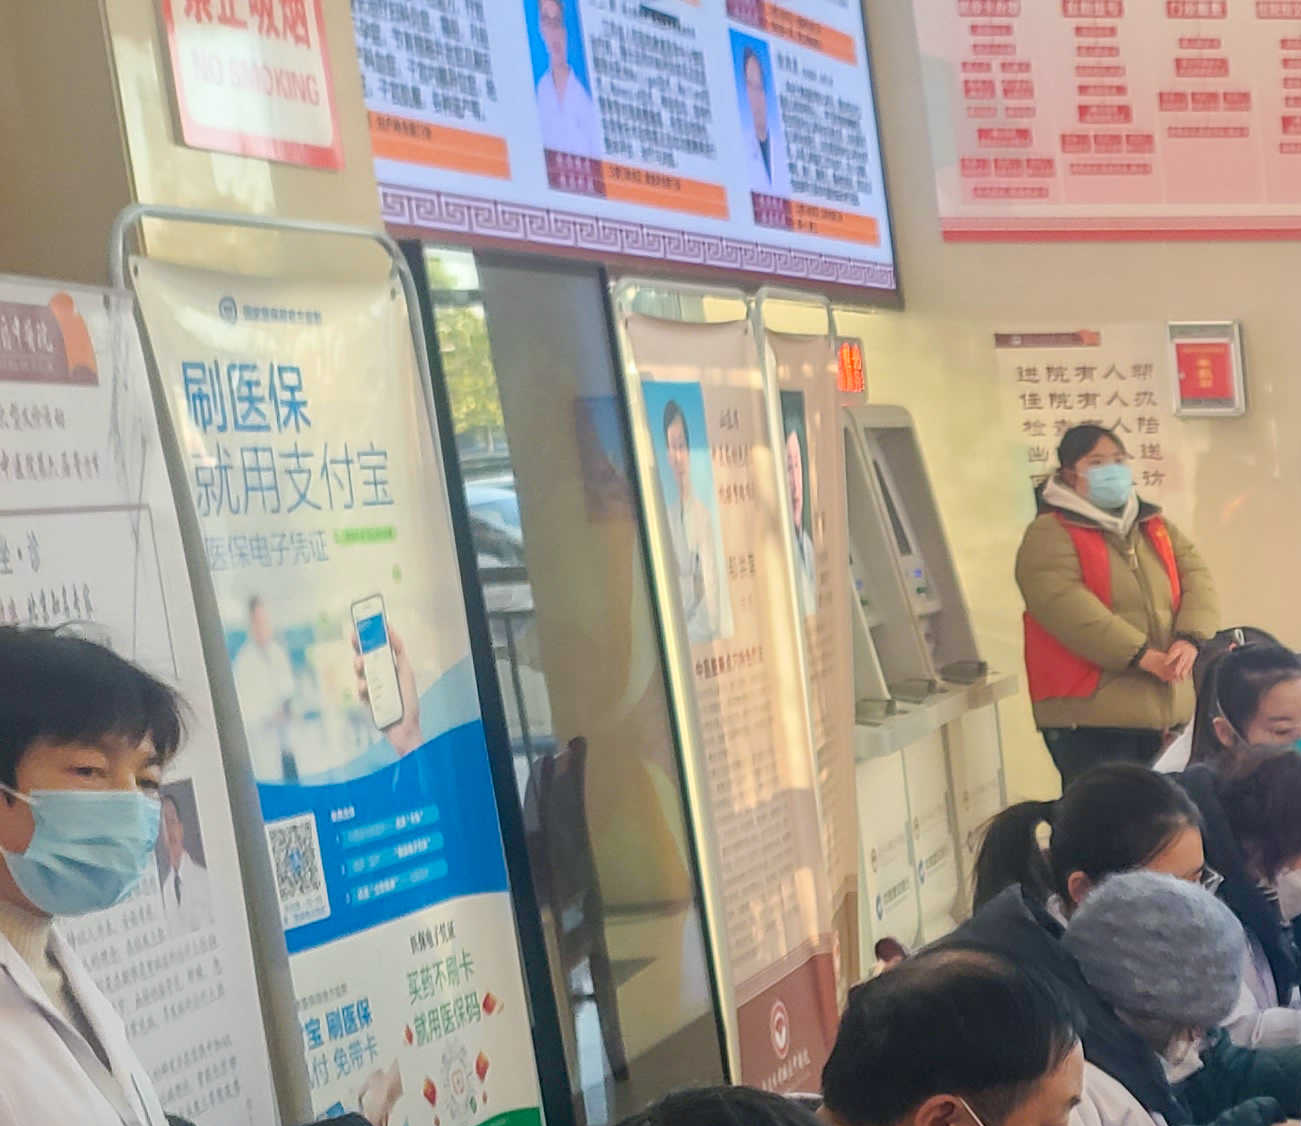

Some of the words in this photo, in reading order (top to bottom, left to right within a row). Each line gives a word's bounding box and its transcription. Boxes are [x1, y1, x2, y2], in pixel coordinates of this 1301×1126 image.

[182, 356, 312, 434] 刷医保
[192, 441, 395, 517] 就用支付宝
[204, 529, 330, 571] 医保电子凭证
[325, 996, 374, 1041] 刷医保
